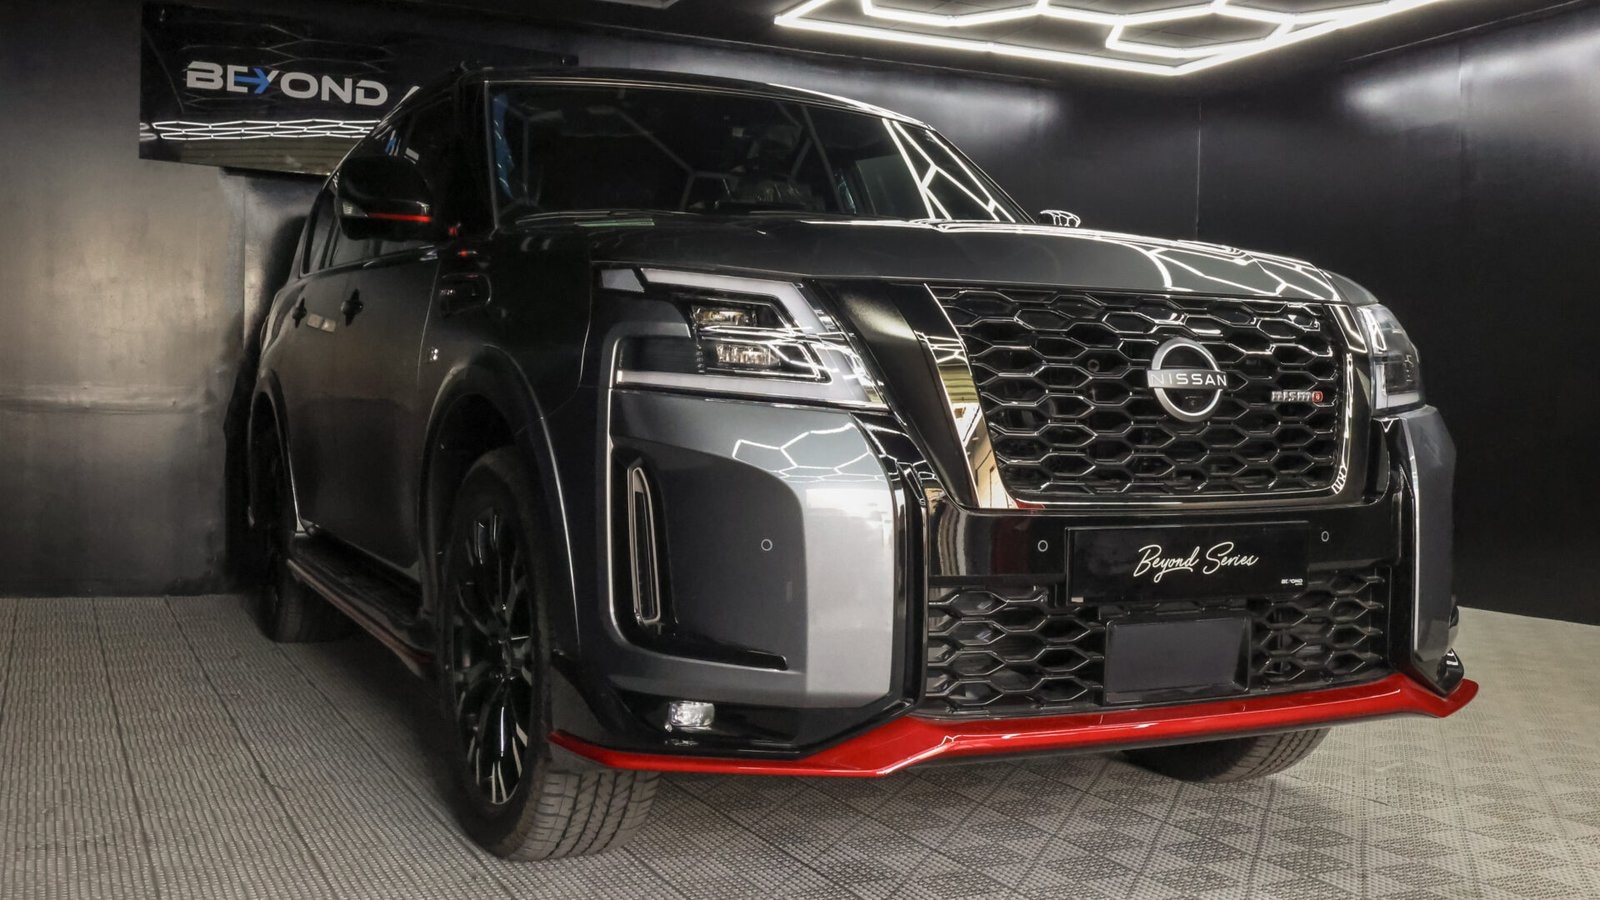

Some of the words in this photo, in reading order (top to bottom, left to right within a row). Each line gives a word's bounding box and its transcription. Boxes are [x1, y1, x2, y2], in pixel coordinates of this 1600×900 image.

[186, 60, 389, 106] BEYOND
[1150, 372, 1228, 387] NISSAN
[1133, 544, 1201, 583] Beyond
[1202, 541, 1259, 575] Series
